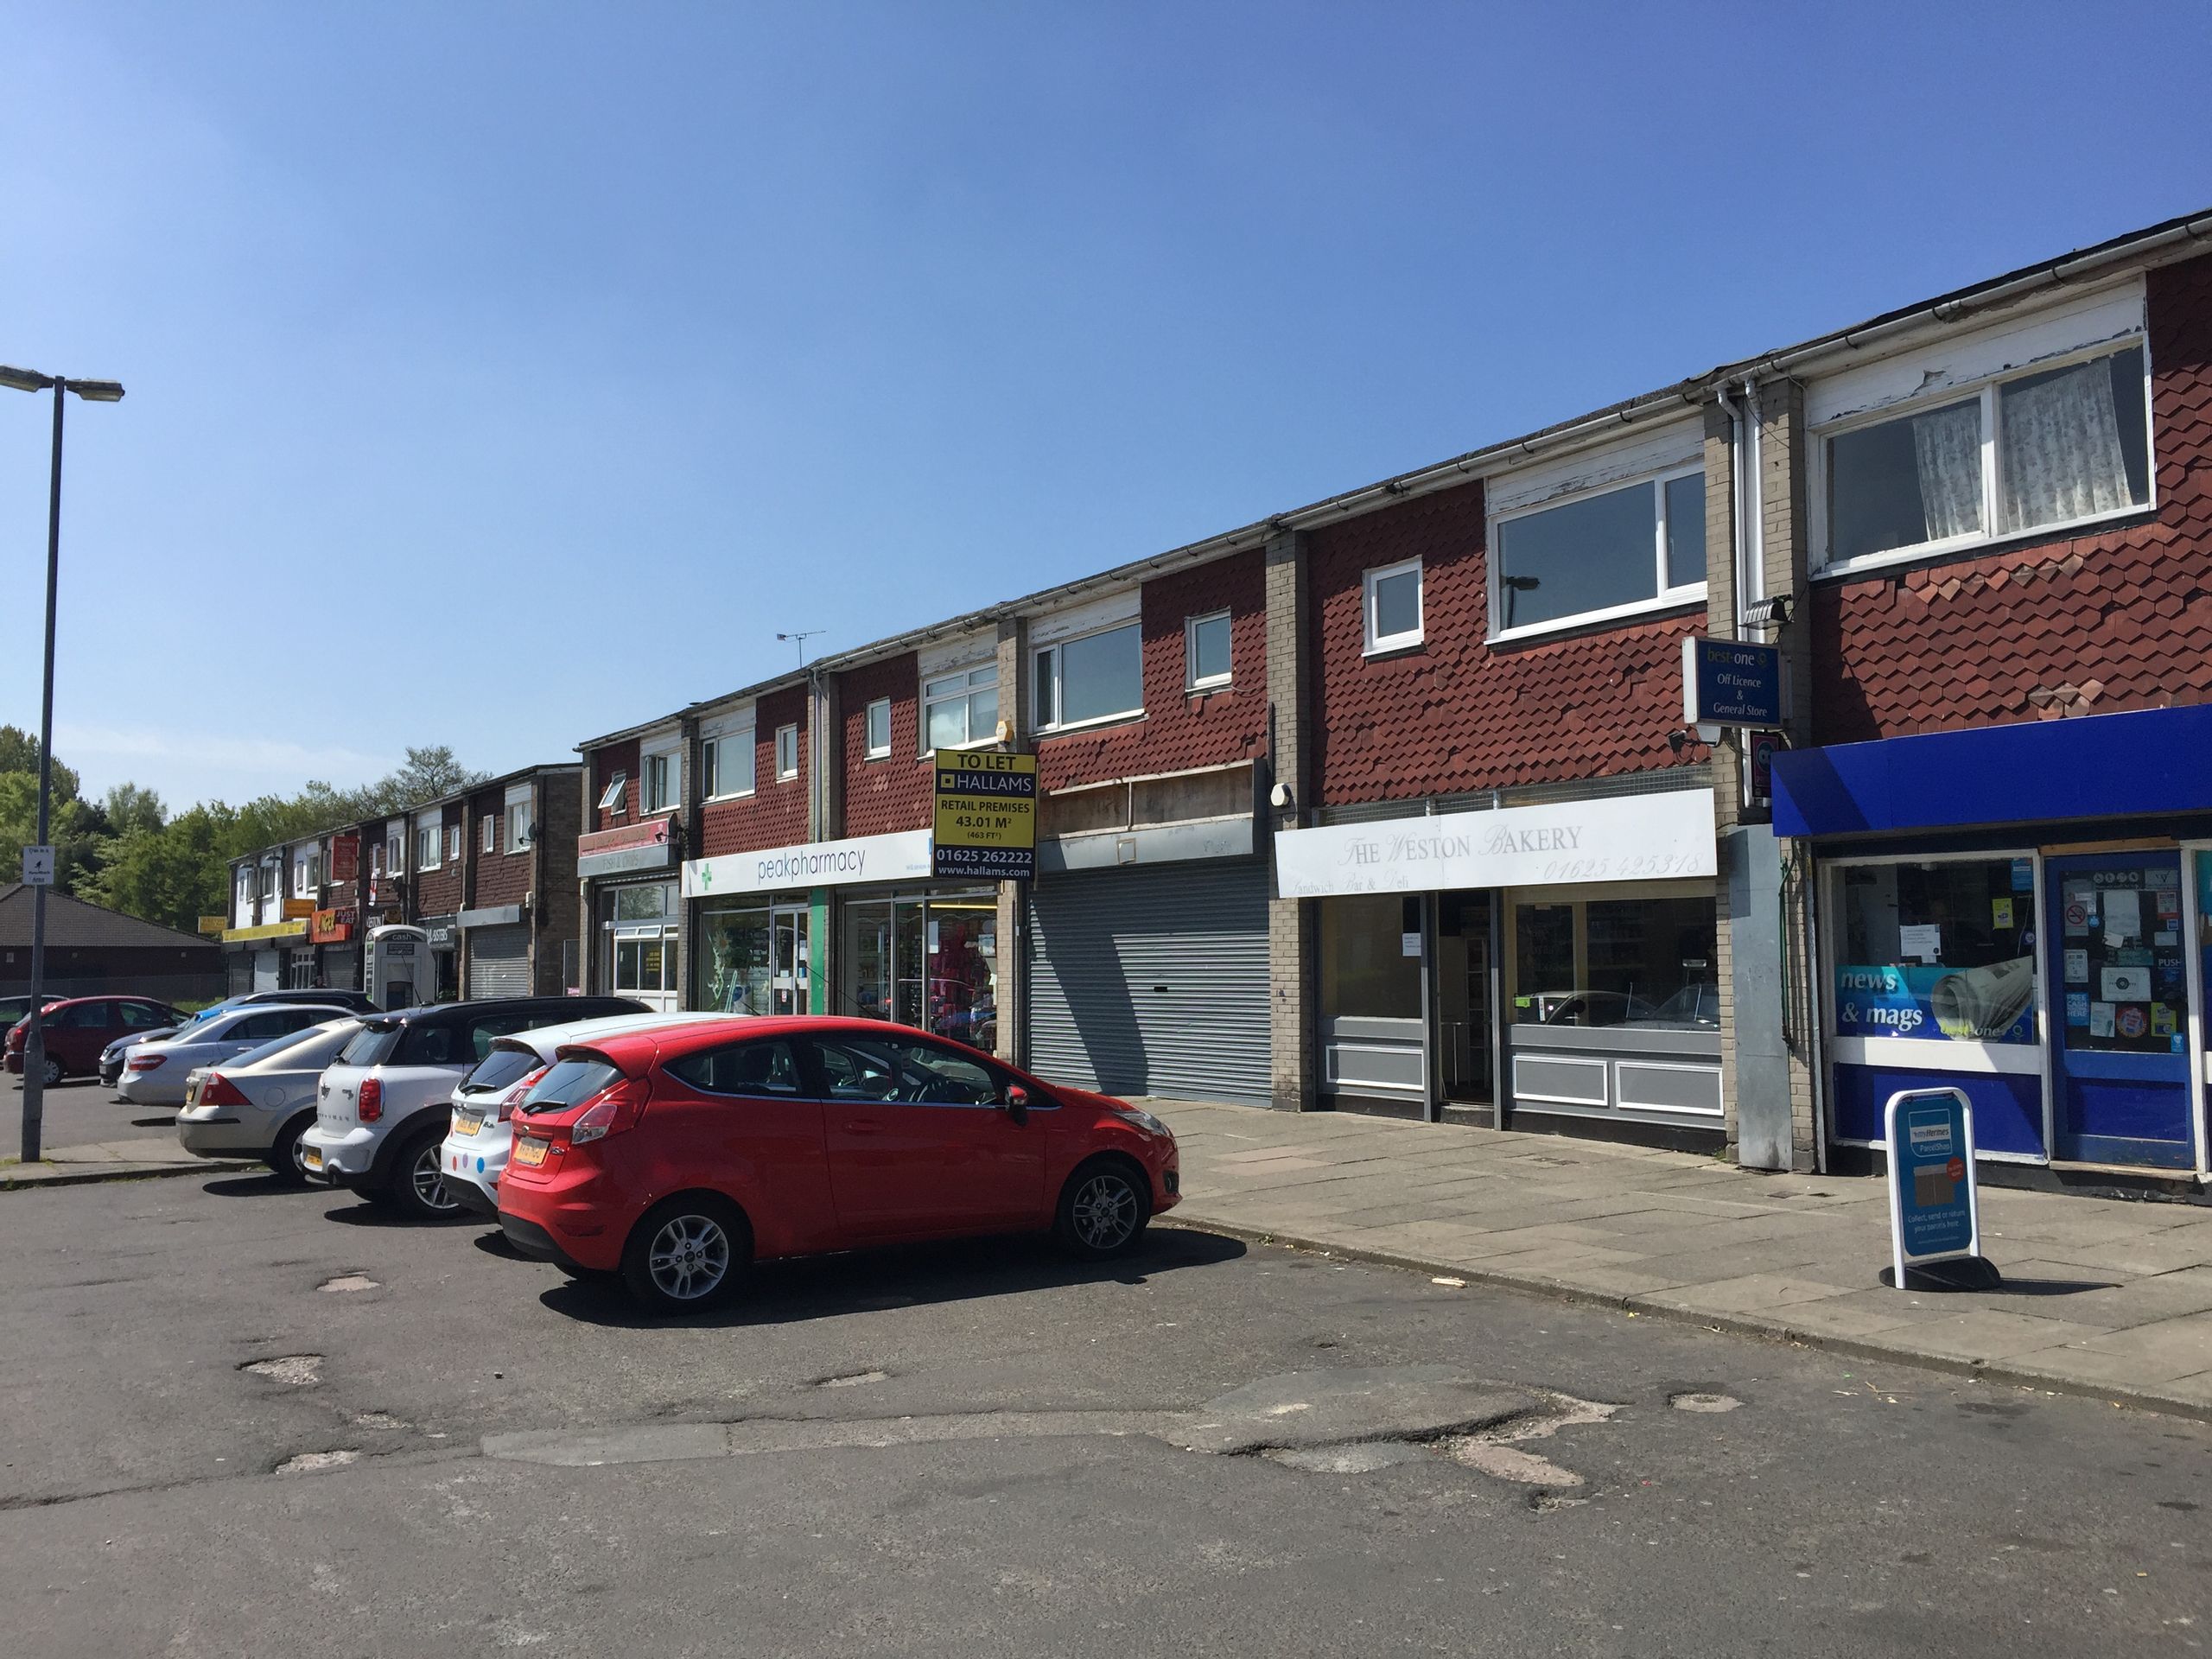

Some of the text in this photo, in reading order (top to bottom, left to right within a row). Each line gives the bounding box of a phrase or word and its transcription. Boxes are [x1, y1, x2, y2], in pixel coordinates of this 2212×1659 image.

[1717, 672, 1762, 688] Off Licence
[1736, 690, 1744, 701] &
[1713, 702, 1768, 717] General Store
[957, 753, 1016, 771] TO LET
[957, 774, 1032, 792] HALLAMS
[941, 799, 1030, 813] RETAIL PREMISES
[956, 816, 990, 828] 43.01
[1338, 823, 1583, 866] THE WESTON BAKERY
[937, 849, 1033, 864] 01625 262222
[758, 849, 866, 885] peakpharmacy
[938, 865, 1030, 877] www.hallams.com
[1543, 857, 1610, 880] 01625
[1367, 877, 1376, 891] &
[392, 933, 411, 942] cash
[1840, 971, 1897, 991] news
[1841, 1002, 1923, 1032] & mags
[1916, 1128, 1949, 1139] myHermes
